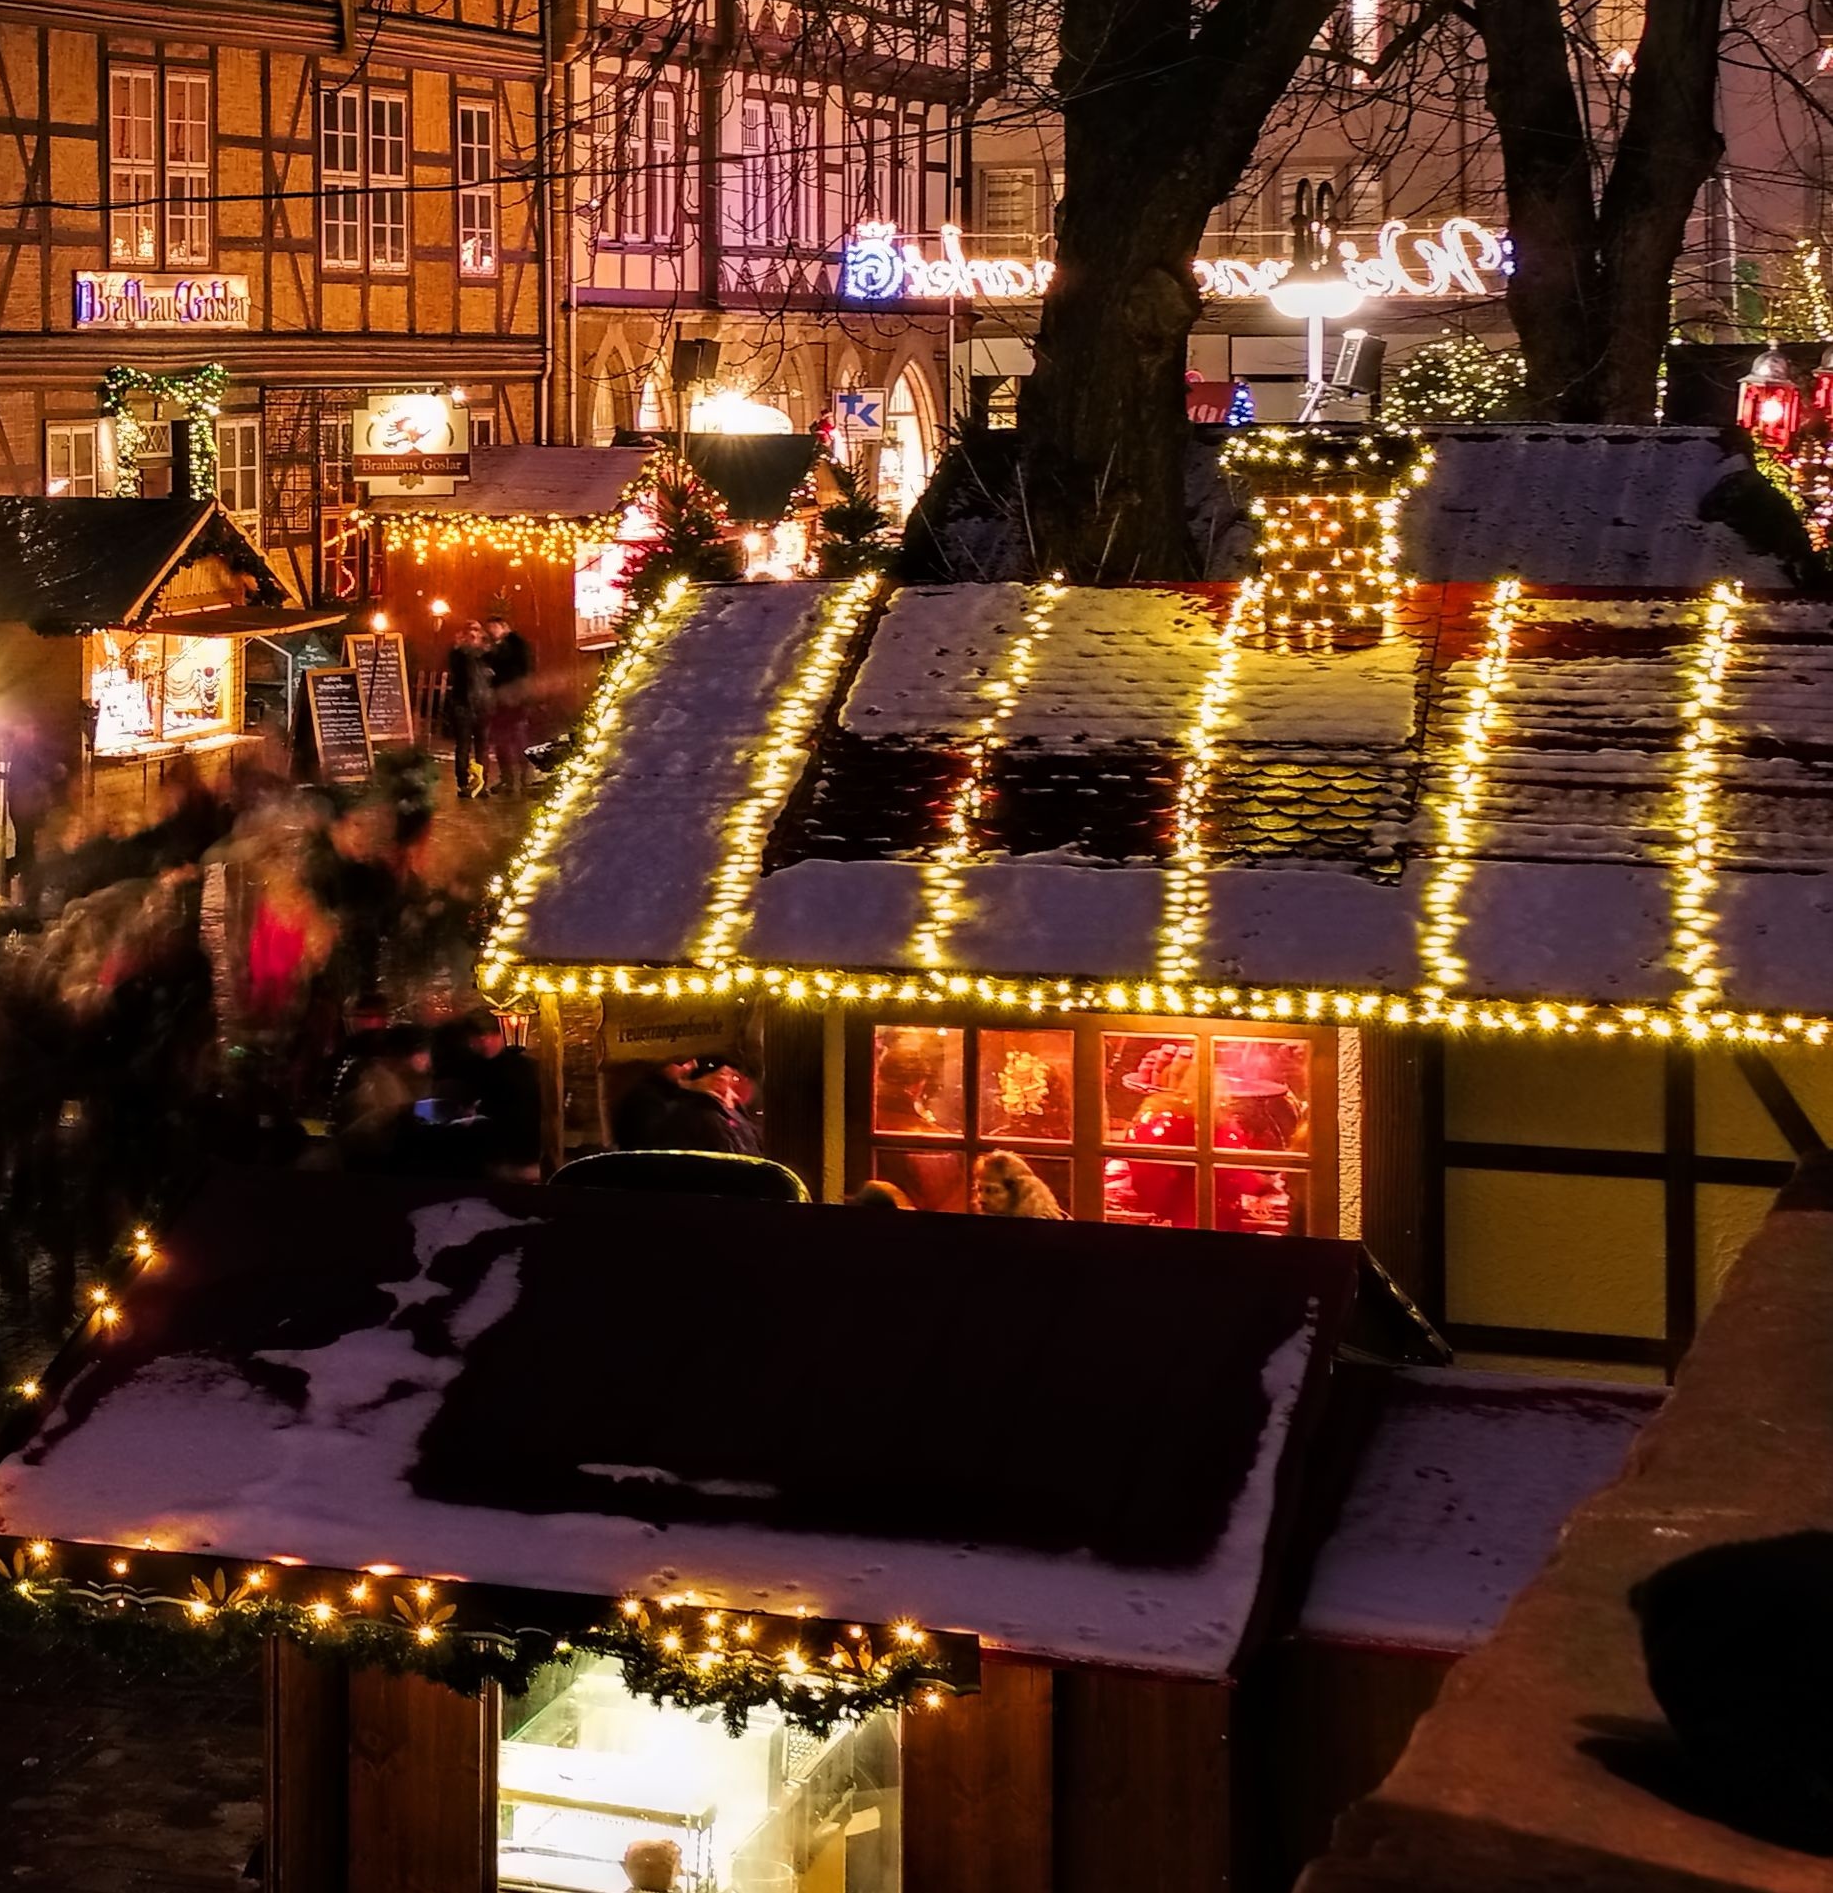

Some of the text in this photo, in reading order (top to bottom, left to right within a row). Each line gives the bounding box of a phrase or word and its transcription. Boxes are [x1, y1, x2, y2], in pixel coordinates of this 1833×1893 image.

[76, 279, 251, 323] Brauhaus Goslar
[839, 394, 881, 427] TK
[361, 457, 462, 471] Brauhaus Goslar
